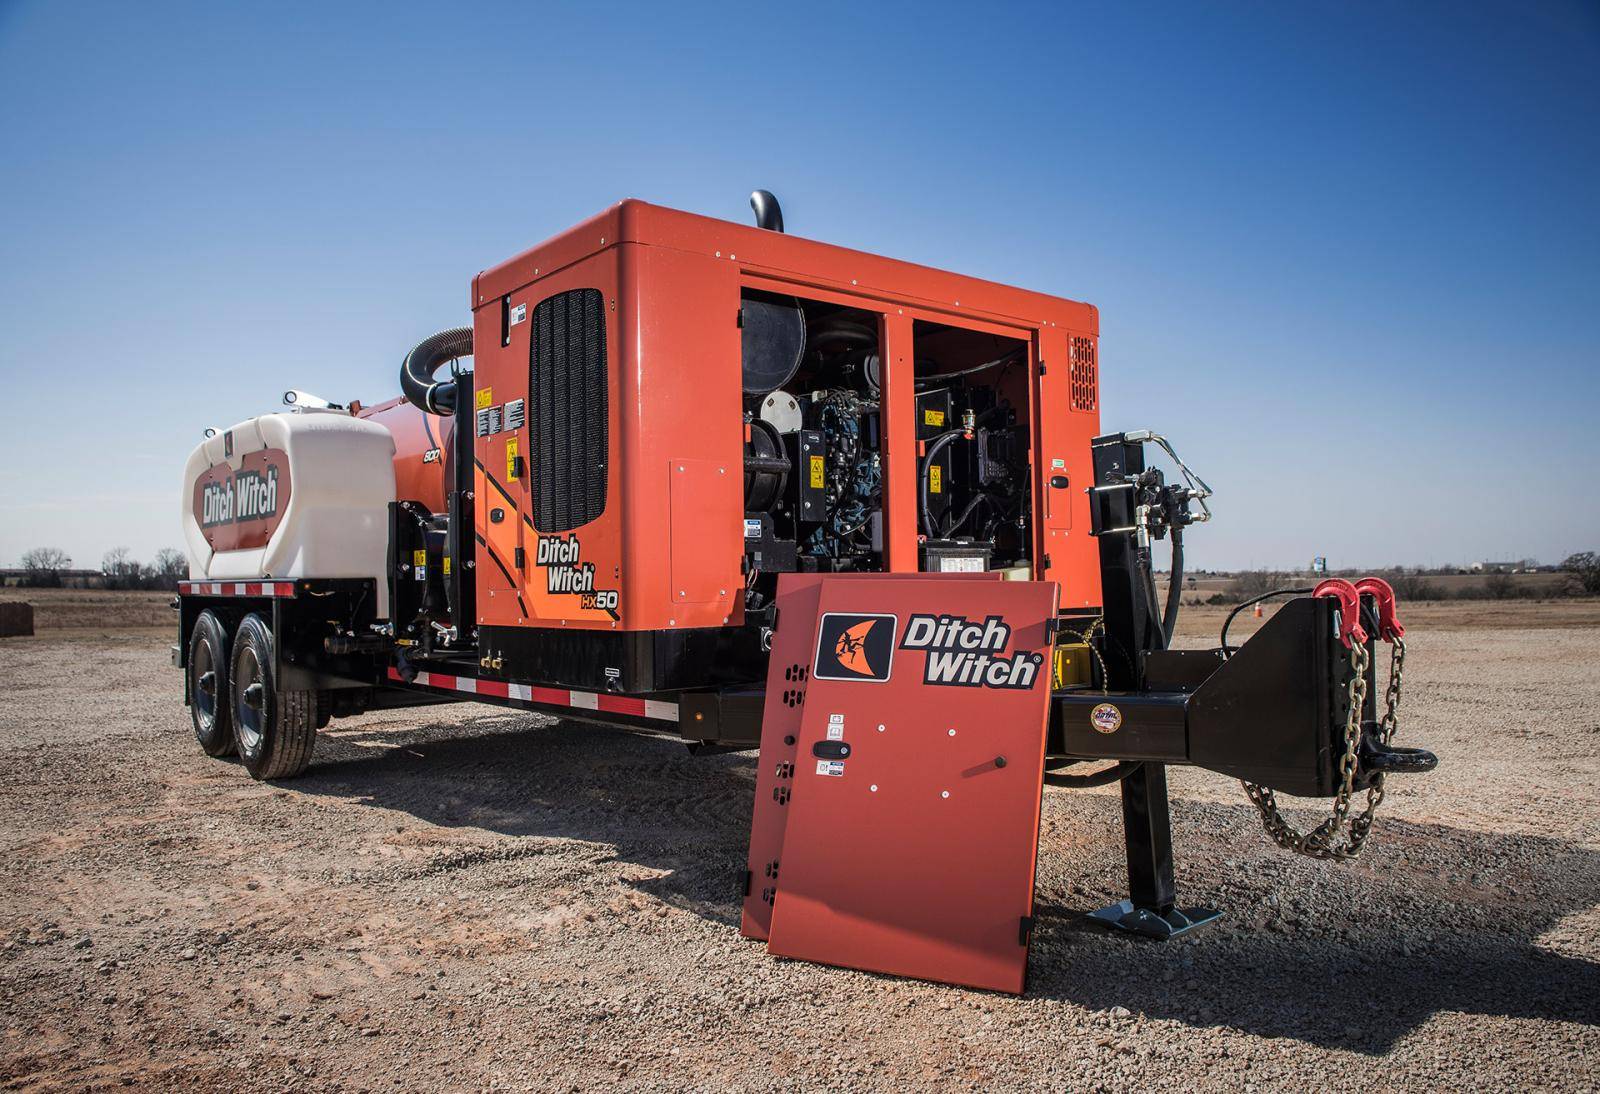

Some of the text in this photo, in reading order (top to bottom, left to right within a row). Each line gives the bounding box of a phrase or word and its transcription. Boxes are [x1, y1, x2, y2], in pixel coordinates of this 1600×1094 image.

[203, 469, 277, 524] Ditch Witch
[537, 536, 579, 564] Ditch
[548, 565, 593, 591] Witch
[581, 592, 618, 609] HX50
[904, 617, 1007, 650] Ditch
